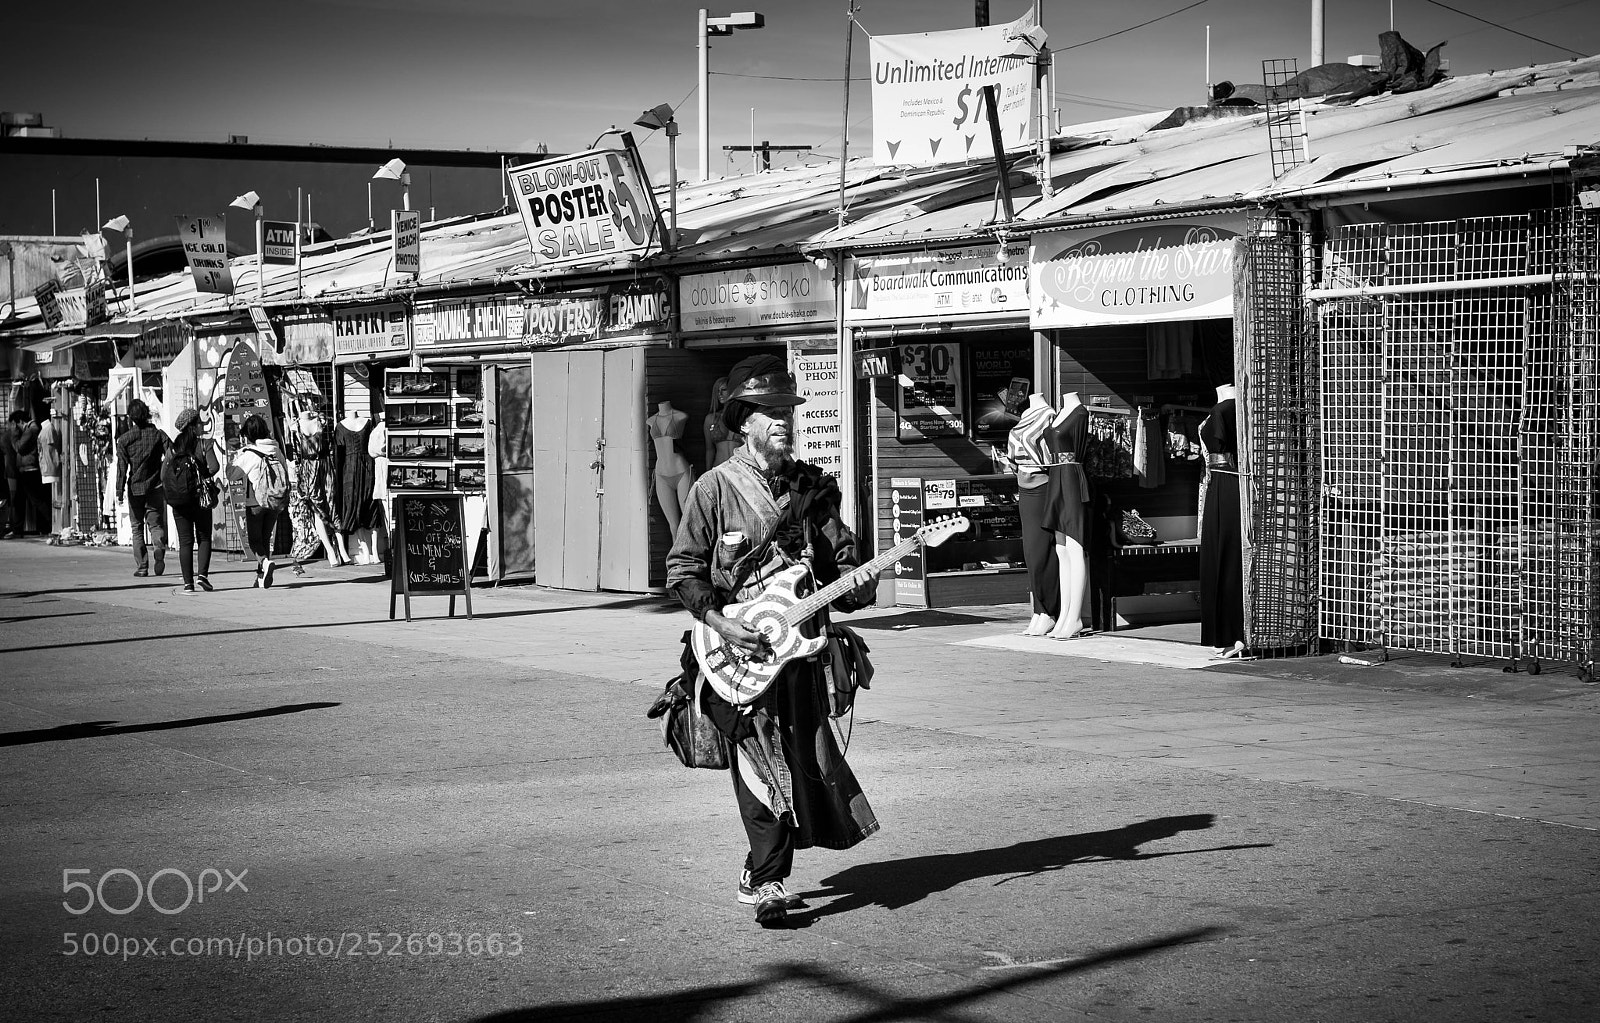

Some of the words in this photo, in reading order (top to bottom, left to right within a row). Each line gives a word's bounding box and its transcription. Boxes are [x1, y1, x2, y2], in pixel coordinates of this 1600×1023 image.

[875, 55, 966, 85] Unlimited
[517, 158, 602, 195] BLOW-OUT
[528, 184, 609, 228] POSTER
[396, 217, 416, 233] VENICE
[266, 229, 294, 243] ATM
[398, 233, 416, 249] BEACH
[538, 218, 616, 259] SALE
[185, 243, 200, 252] ICE
[201, 243, 225, 253] COLD
[266, 247, 293, 256] INSIDE
[192, 258, 224, 268] DRINKS
[396, 253, 418, 265] PHOTOS
[873, 268, 928, 292] Boardwalk
[930, 263, 1028, 287] Communications
[1054, 238, 1143, 302] Beyond
[1140, 236, 1169, 281] the
[691, 277, 740, 306] double
[760, 271, 810, 300] shaka
[1101, 283, 1195, 307] CLOTHING
[937, 294, 950, 305] ATM
[87, 303, 105, 321] RICE
[434, 303, 472, 341] HANDMADE
[473, 300, 507, 339] JEWELRY
[530, 301, 592, 336] POSTERS
[609, 291, 671, 326] FRAMING
[335, 310, 386, 337] RAFIKI
[862, 356, 889, 376] ATM
[904, 344, 950, 376] $30
[900, 421, 912, 430] 4G
[808, 456, 832, 465] HANDS
[924, 484, 938, 493] 4G
[408, 543, 422, 555] ALL
